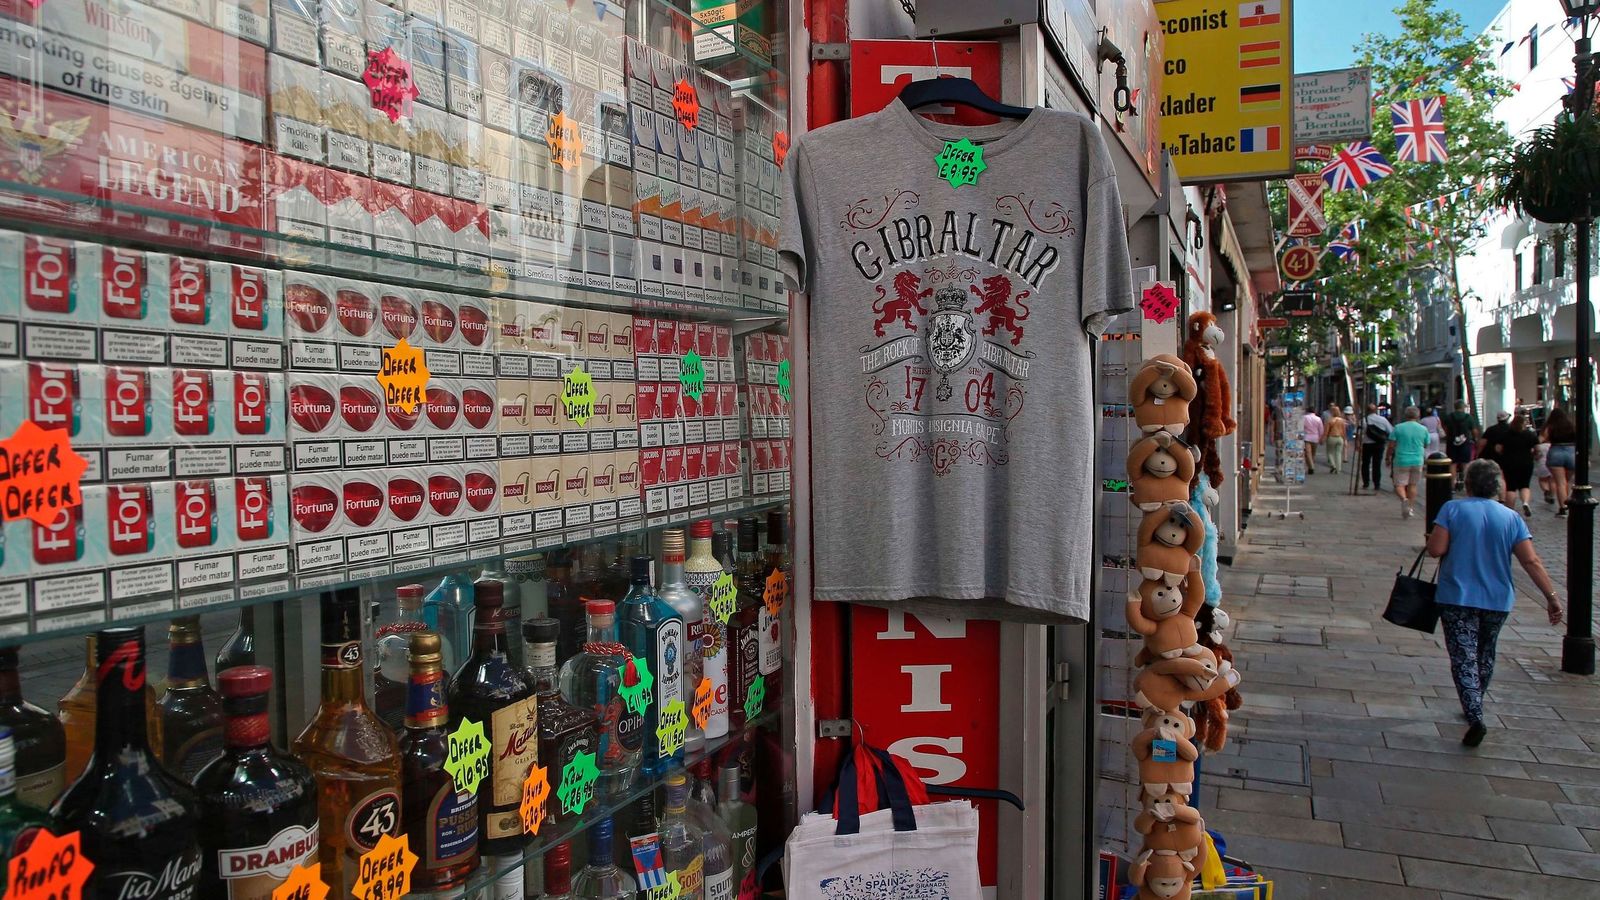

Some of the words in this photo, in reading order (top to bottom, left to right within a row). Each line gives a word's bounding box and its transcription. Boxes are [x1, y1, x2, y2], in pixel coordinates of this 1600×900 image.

[84, 1, 151, 43] Winston
[1160, 9, 1228, 36] cconist
[0, 28, 85, 70] moking
[92, 56, 164, 90] causes
[169, 79, 230, 112] ageing
[1163, 59, 1187, 77] co
[1294, 78, 1318, 89] and
[61, 71, 85, 89] of
[90, 75, 124, 101] the
[129, 87, 169, 113] skin
[1295, 86, 1354, 97] broidery
[1305, 118, 1365, 130] Bordado
[280, 125, 319, 144] Smoking
[1169, 142, 1180, 157] de
[1179, 134, 1236, 157] Tabac
[98, 131, 240, 181] AMERICAN
[942, 144, 975, 163] OFFER
[940, 162, 978, 183] £9.95
[97, 153, 240, 214] LEGEND
[584, 204, 606, 218] Smoking
[850, 210, 1061, 294] GIBRALTAR
[1287, 253, 1310, 272] 41
[340, 308, 374, 320] Fortuna
[384, 313, 415, 324] Fortuna
[424, 316, 453, 328] Fortuna
[461, 320, 487, 332] Fortuna
[246, 345, 270, 354] Fumar
[305, 345, 326, 354] Fumar
[234, 354, 258, 367] puede
[260, 354, 280, 365] matar
[295, 357, 317, 367] puede
[319, 355, 335, 365] matar
[384, 352, 417, 378] OFFER
[860, 351, 881, 373] THE
[883, 340, 909, 363] ROCK
[981, 341, 1030, 378] GIBRALTAR
[387, 383, 421, 404] OFFER
[565, 378, 589, 397] OFFER
[905, 365, 927, 412] 17
[965, 372, 996, 413] 04
[293, 402, 331, 416] Fortuna
[343, 402, 377, 416] Fortuna
[428, 402, 457, 413] Fortuna
[465, 402, 491, 413] Fortuna
[569, 402, 590, 419] OFFER
[0, 444, 61, 481] OFFER
[125, 452, 154, 462] Fumar
[112, 464, 139, 476] puede
[142, 462, 167, 474] matar
[467, 486, 494, 497] Fortuna
[506, 485, 522, 495] Nobel
[537, 482, 554, 491] Nobel
[6, 484, 74, 519] OFFER
[391, 493, 422, 506] Fortuna
[431, 490, 460, 501] Fortuna
[296, 502, 334, 515] Fortuna
[346, 497, 380, 510] Fortuna
[194, 561, 219, 572] Fumar
[182, 574, 205, 586] puede
[207, 569, 231, 581] matar
[344, 646, 360, 665] 43
[660, 709, 683, 731] OFFER
[451, 733, 482, 764] OFFER
[359, 802, 397, 838] 43
[362, 847, 404, 885] OFFER
[866, 879, 900, 891] SPAIN
